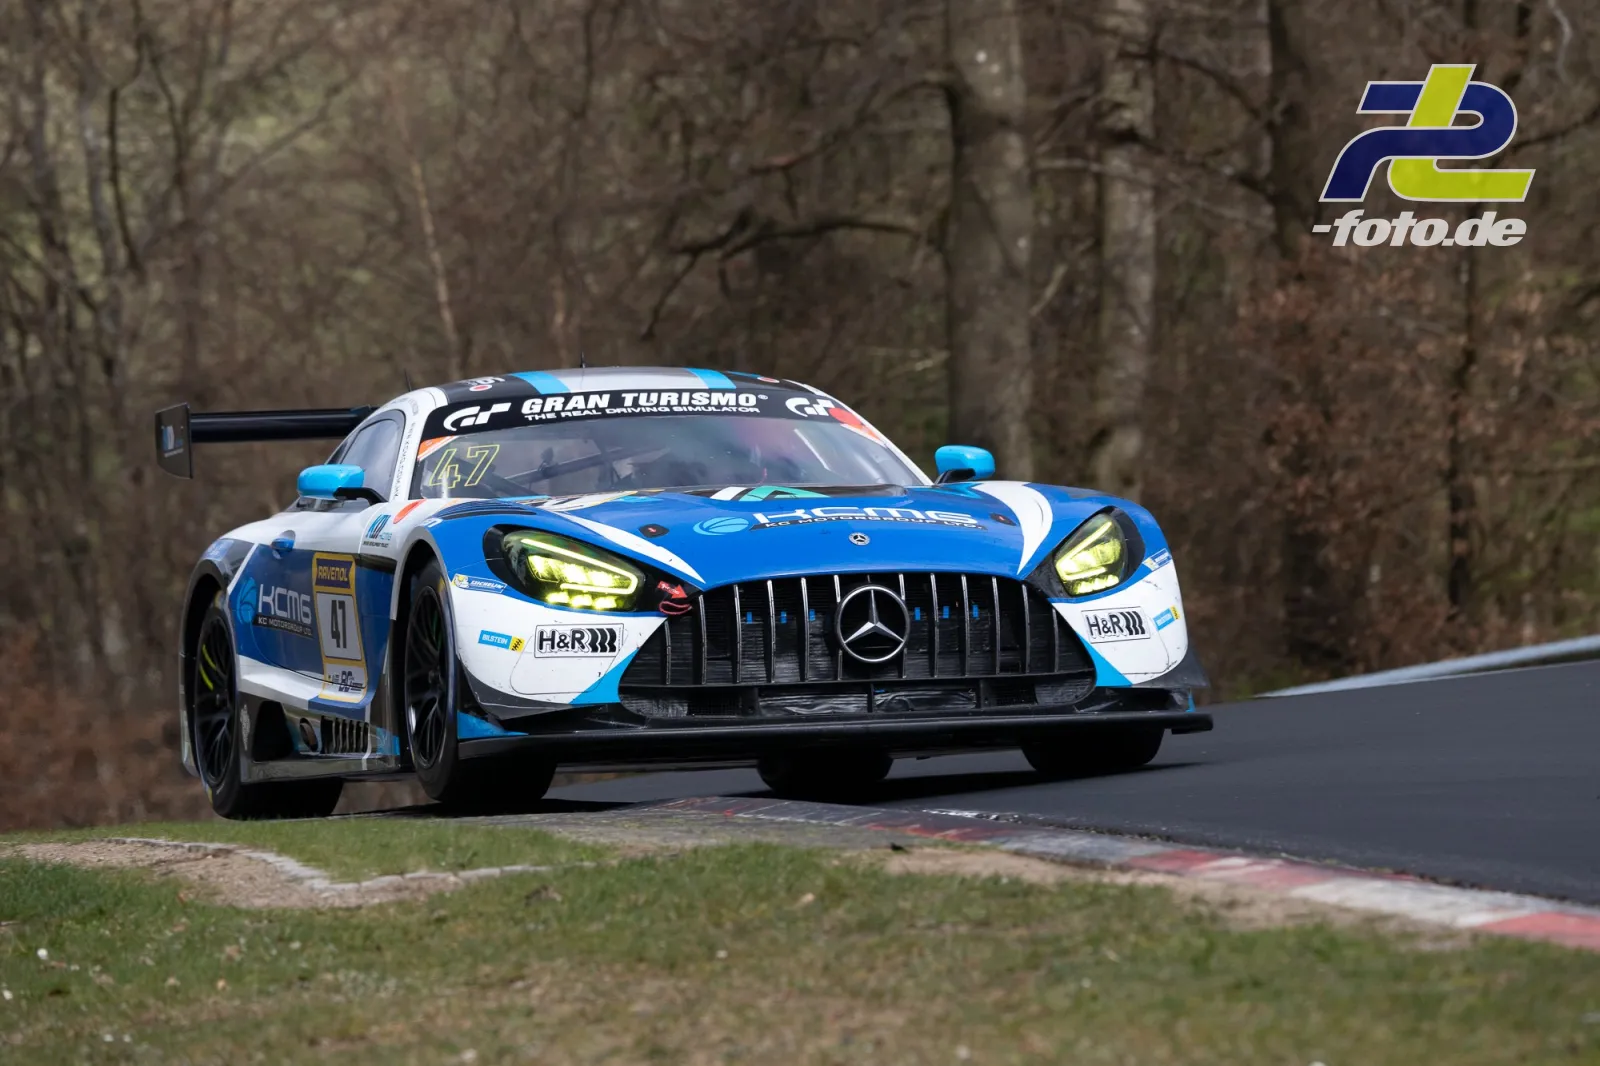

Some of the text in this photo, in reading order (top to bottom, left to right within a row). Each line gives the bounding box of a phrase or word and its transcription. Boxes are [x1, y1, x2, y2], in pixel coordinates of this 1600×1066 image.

[521, 394, 611, 415] GRAN
[524, 411, 557, 421] THE
[561, 408, 602, 417] REAL
[605, 406, 671, 415] DRIVING
[429, 444, 500, 489] 47
[798, 515, 937, 524] MOTORGROUP
[318, 565, 348, 582] RAVENOL
[258, 616, 268, 625] KC
[331, 599, 347, 649] 47
[1085, 613, 1124, 637] H&R
[481, 633, 509, 646] BILSTEIN
[538, 628, 586, 650] H&R
